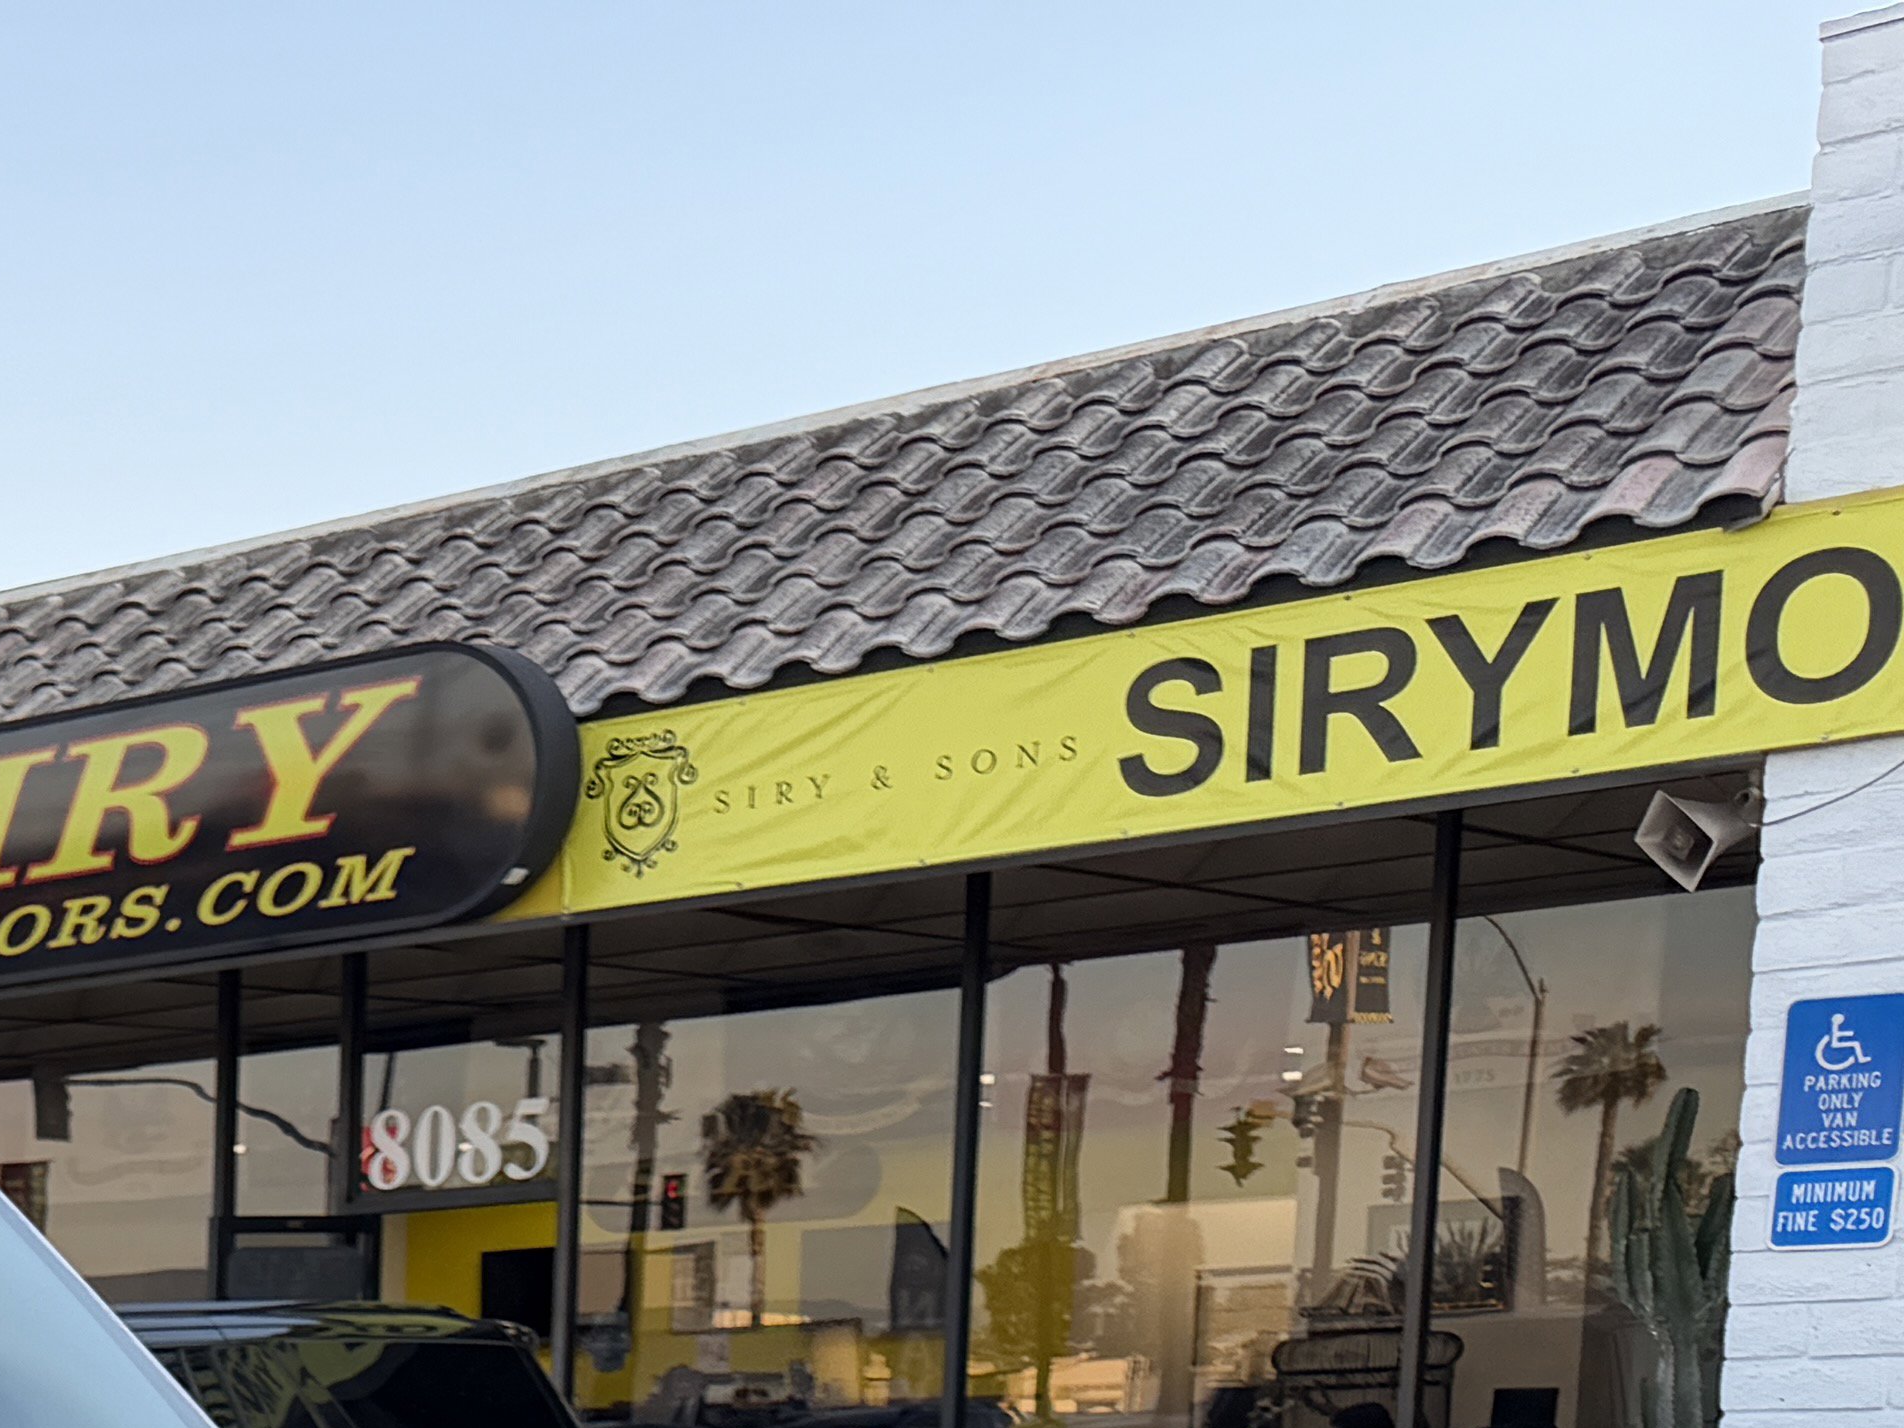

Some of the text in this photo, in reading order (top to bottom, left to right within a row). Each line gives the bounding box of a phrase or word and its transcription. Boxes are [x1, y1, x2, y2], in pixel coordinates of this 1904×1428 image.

[713, 736, 1078, 815] SIRY & SONS
[1803, 1071, 1882, 1092] PARKING
[1818, 1091, 1863, 1111] ONLY
[1821, 1111, 1857, 1128] VAN
[368, 1098, 550, 1190] 8085
[1782, 1128, 1892, 1150] ACCESSIBLE
[1792, 1180, 1877, 1205] MINIMUM
[1776, 1207, 1885, 1233] FINE $250
